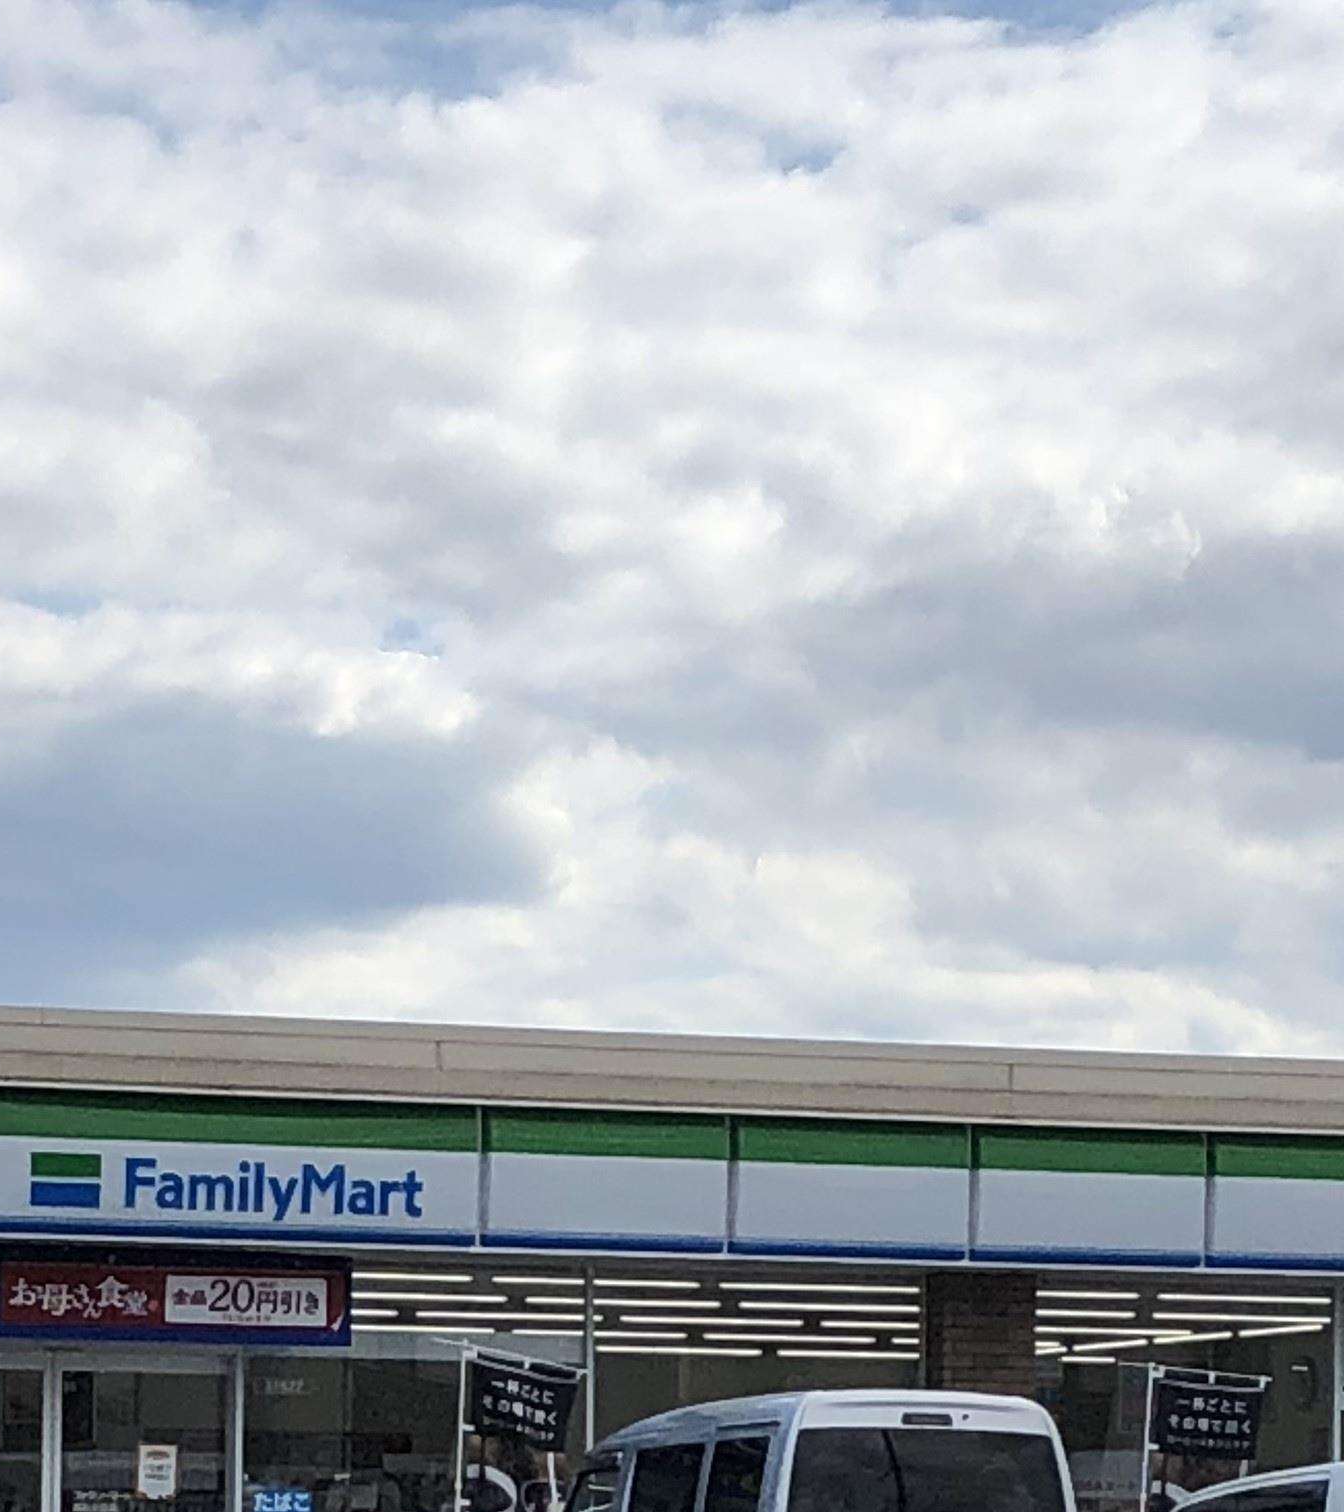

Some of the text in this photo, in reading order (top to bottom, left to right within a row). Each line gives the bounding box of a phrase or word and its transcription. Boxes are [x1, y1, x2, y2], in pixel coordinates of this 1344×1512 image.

[124, 1156, 424, 1221] FamilyMart
[8, 1275, 148, 1319] お母さん食堂
[254, 1492, 310, 1512] たばこ
